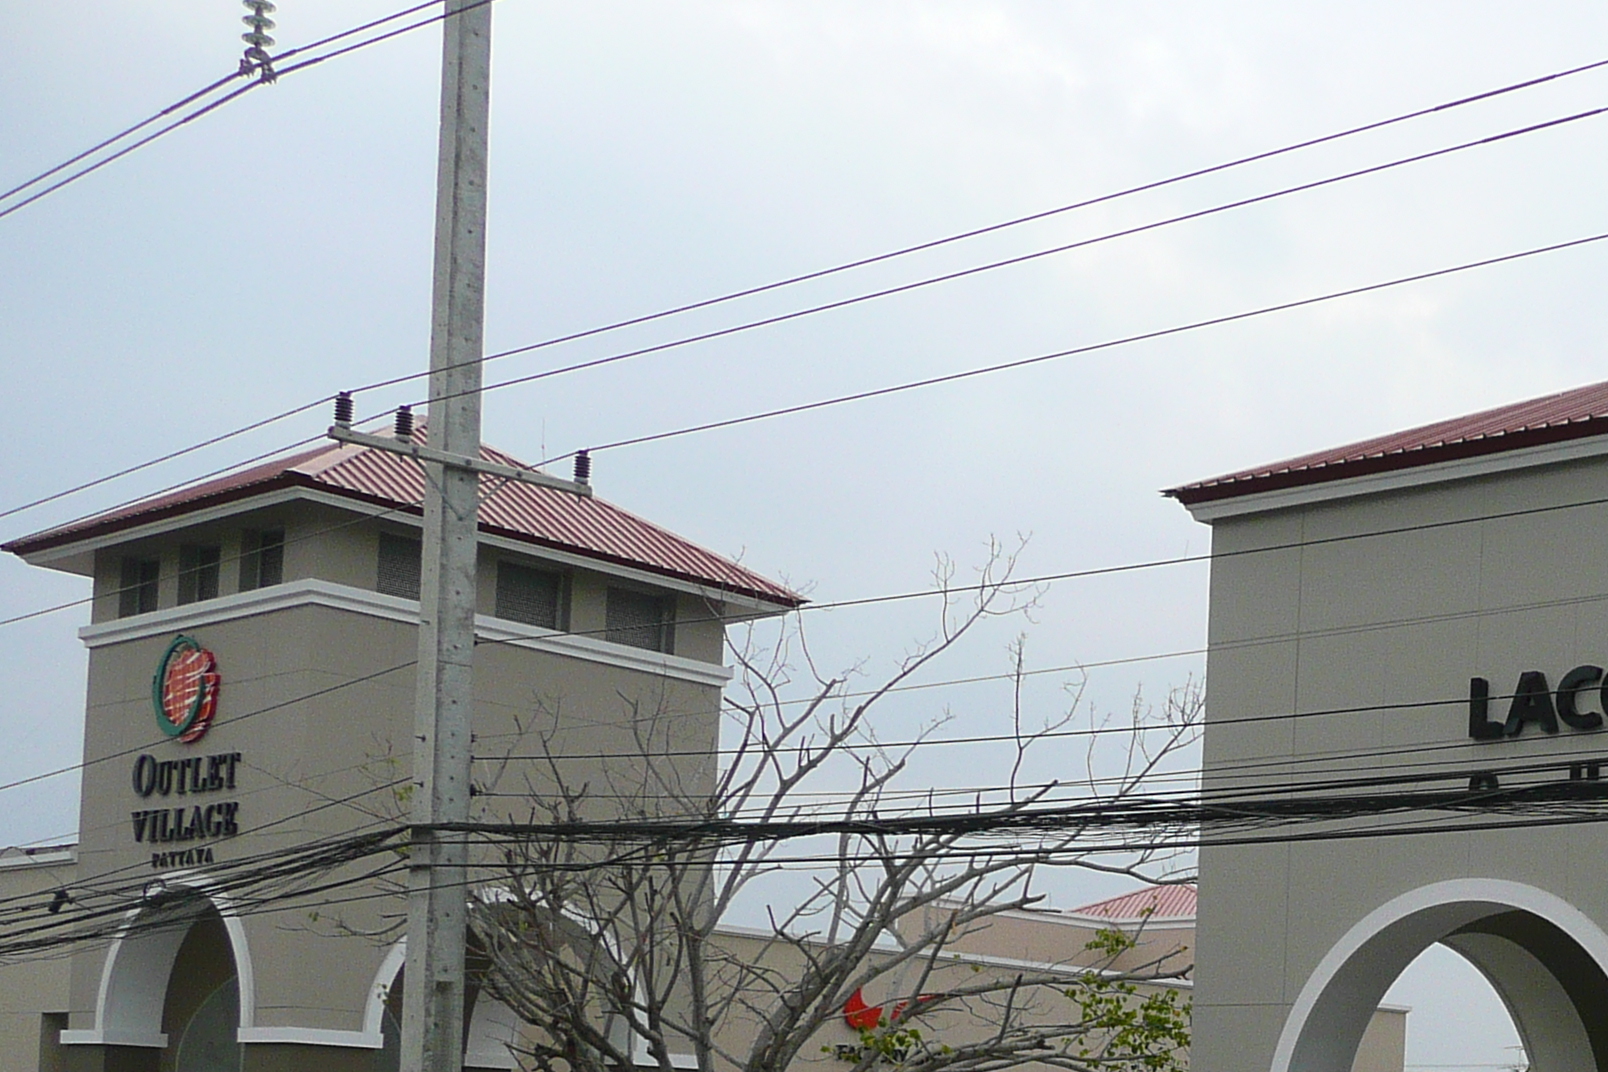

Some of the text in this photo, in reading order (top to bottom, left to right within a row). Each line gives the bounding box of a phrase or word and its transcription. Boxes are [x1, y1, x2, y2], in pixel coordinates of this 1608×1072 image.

[132, 752, 242, 797] OUTLET
[131, 801, 239, 843] VILLAGE
[151, 847, 214, 869] PATTAYA
